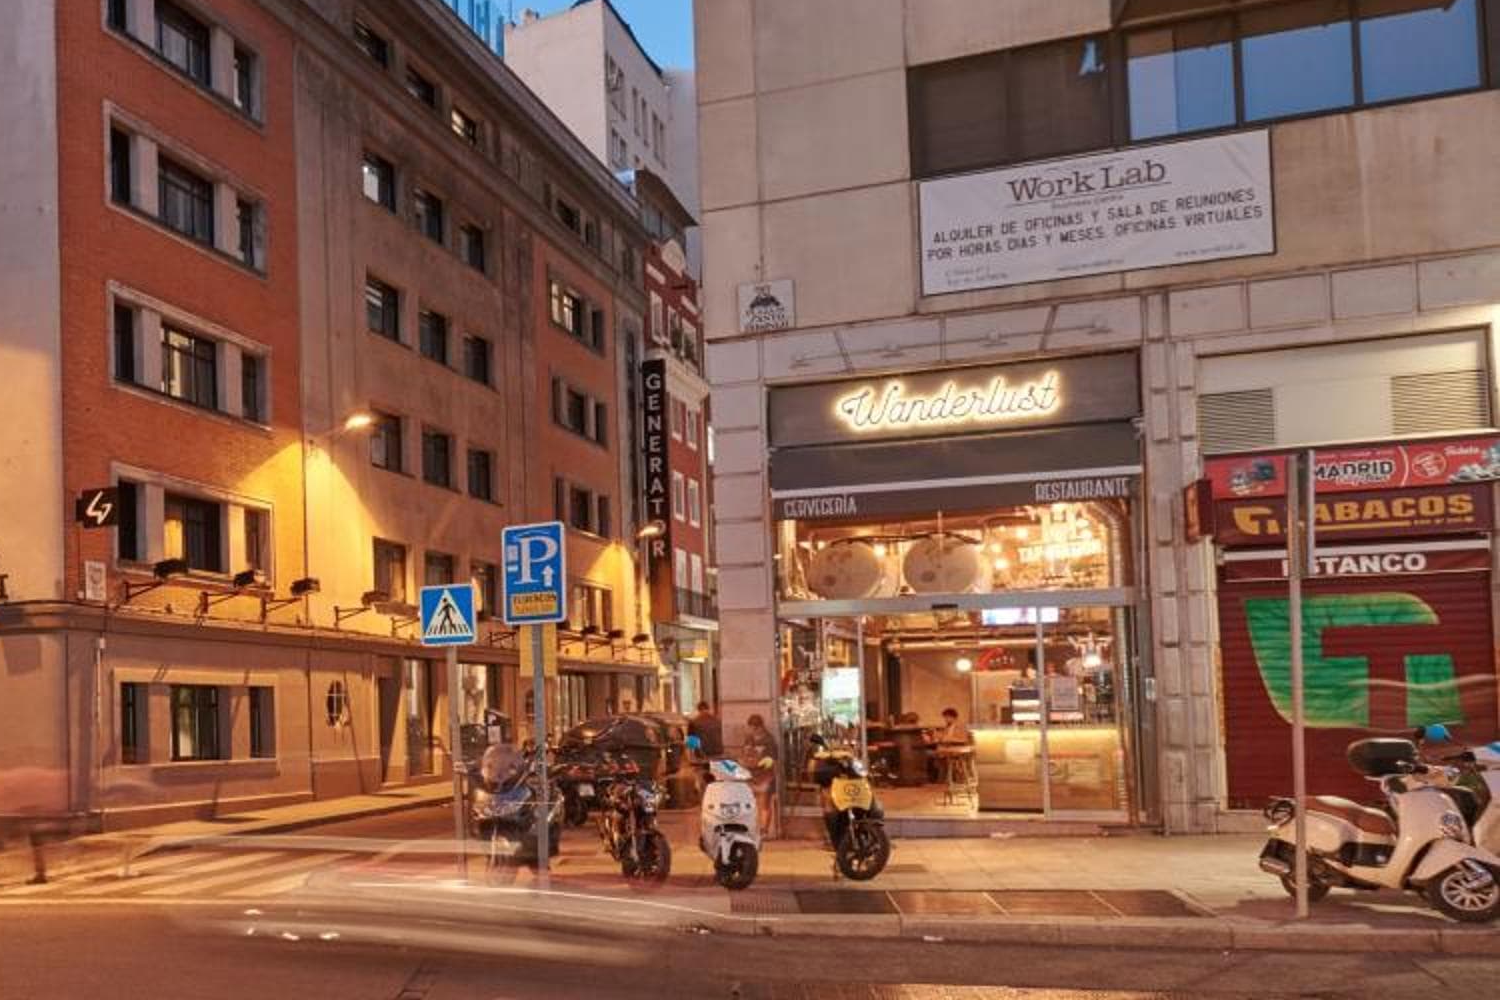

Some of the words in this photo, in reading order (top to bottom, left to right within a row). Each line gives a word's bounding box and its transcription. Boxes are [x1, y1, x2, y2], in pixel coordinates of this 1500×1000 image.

[1007, 170, 1095, 201] Work
[1100, 160, 1167, 189] Lab
[927, 247, 952, 262] POR
[959, 239, 1002, 258] HORAS
[1114, 215, 1177, 237] OFICINAS
[1183, 204, 1264, 228] VIRTUALES
[933, 224, 993, 244] ALQUILER
[1001, 221, 1018, 235] DE
[1025, 212, 1083, 232] OFICINAS
[1107, 204, 1144, 221] SALA
[1151, 199, 1169, 215] DE
[1175, 187, 1256, 211] REUNIONES
[838, 371, 1060, 430] Wanderlust
[645, 372, 668, 557] GENERATOR
[1035, 478, 1129, 501] RESTAURANTE
[1314, 494, 1474, 522] ABACOS
[513, 535, 559, 585] P
